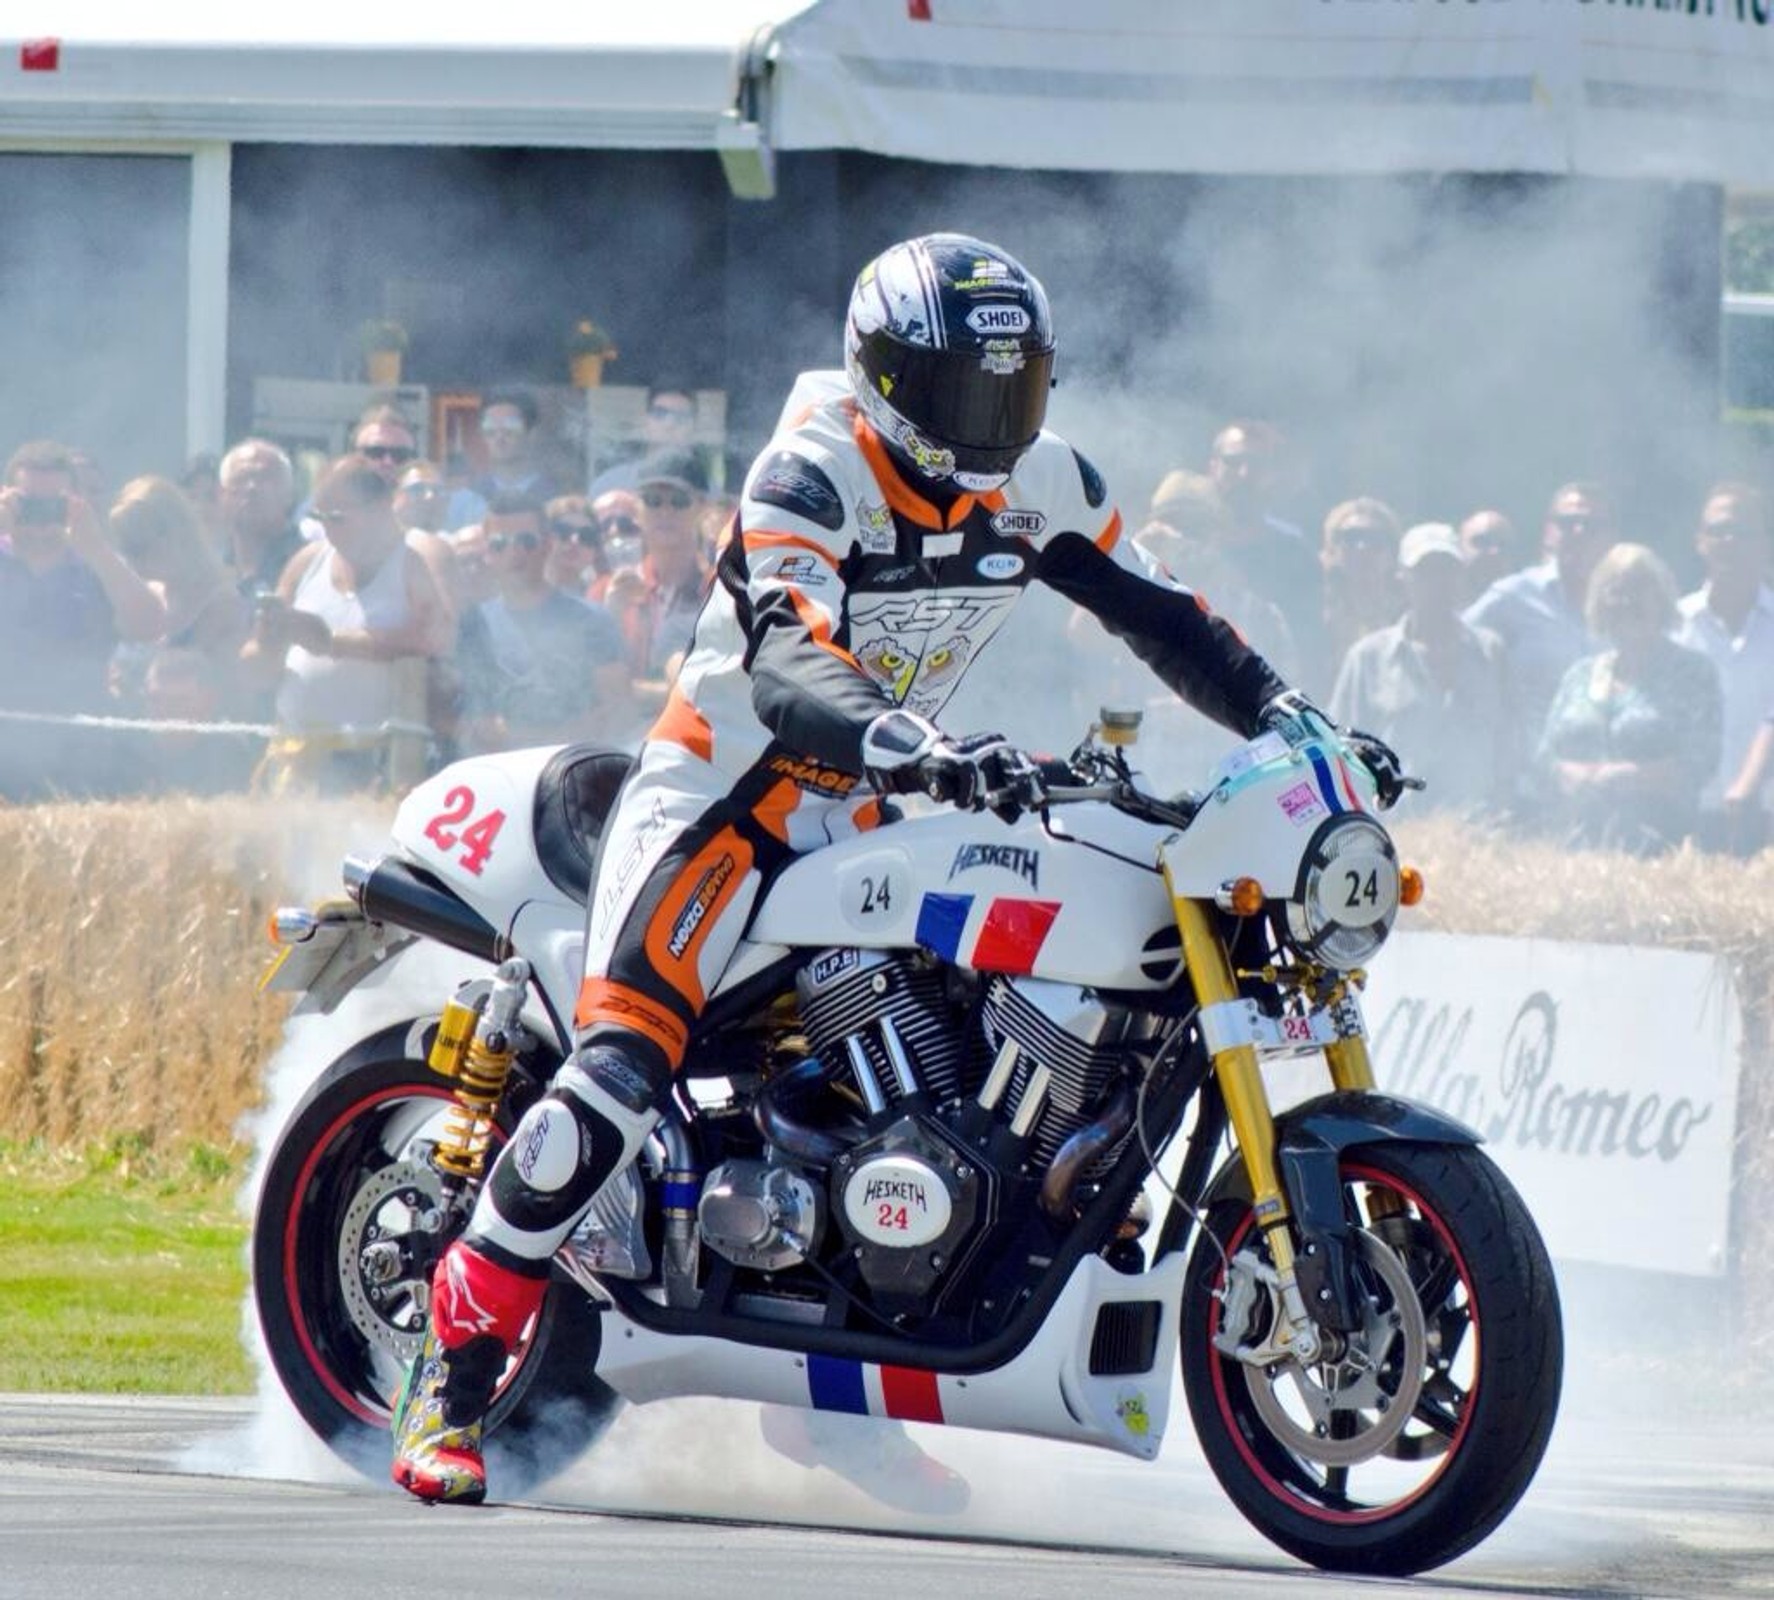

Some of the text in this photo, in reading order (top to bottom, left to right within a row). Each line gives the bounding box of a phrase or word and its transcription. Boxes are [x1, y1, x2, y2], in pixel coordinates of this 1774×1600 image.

[977, 311, 1023, 327] SHOEI
[1000, 516, 1040, 531] SHOEI
[850, 594, 1015, 633] RST
[423, 785, 507, 877] 24
[947, 844, 1039, 893] HESKETH
[860, 875, 891, 914] 24
[1344, 869, 1379, 907] 24
[1284, 1018, 1313, 1041] 24
[1488, 989, 1712, 1163] Romeo
[863, 1180, 927, 1213] HESKETH
[878, 1203, 909, 1230] 24
